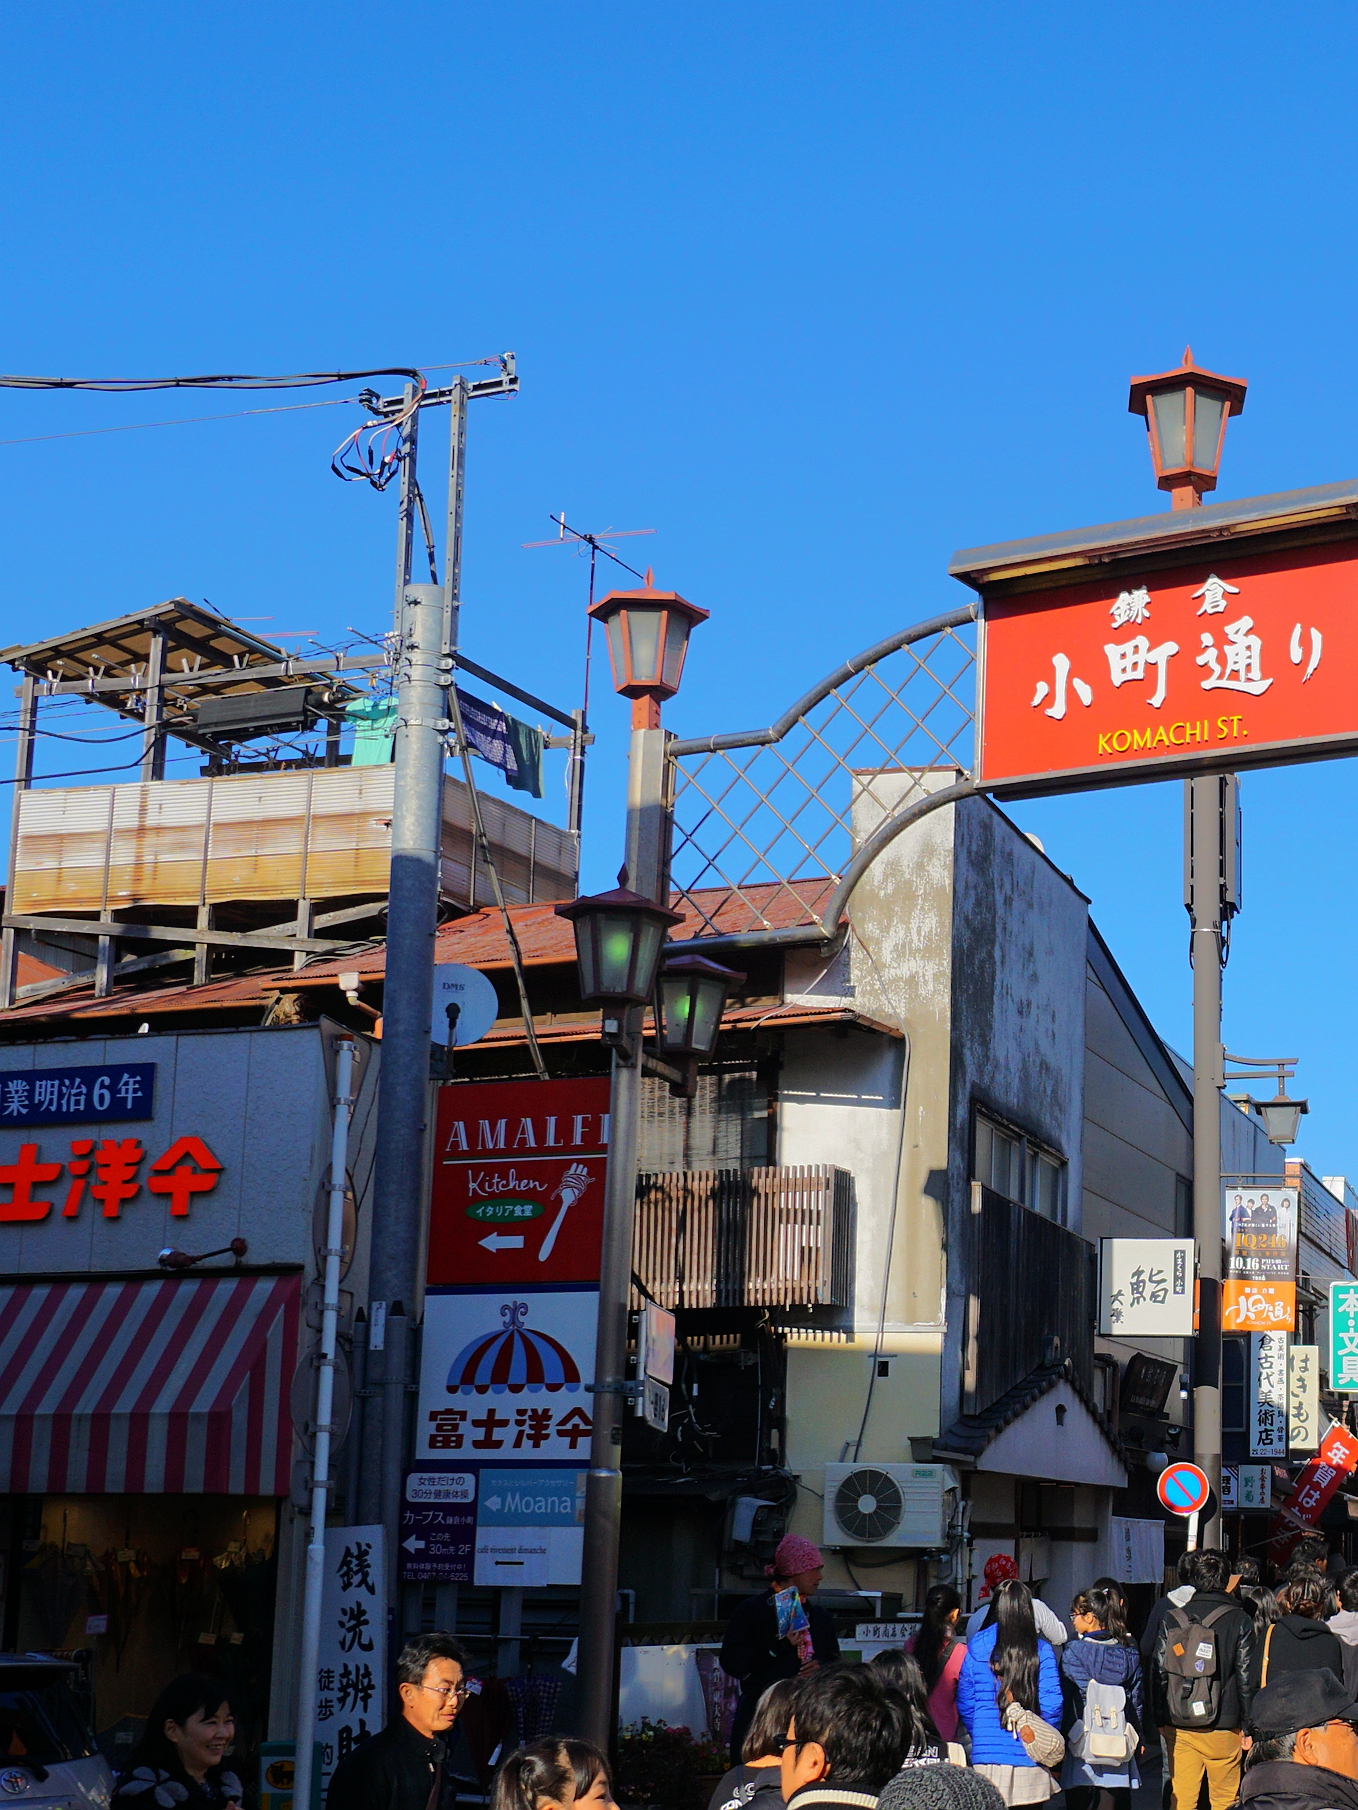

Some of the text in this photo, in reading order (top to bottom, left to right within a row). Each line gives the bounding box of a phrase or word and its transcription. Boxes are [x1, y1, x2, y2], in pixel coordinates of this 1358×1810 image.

[1109, 573, 1240, 629] 鎌倉
[1030, 616, 1323, 721] 小町通り
[1097, 715, 1250, 755] KOMACHI ST.
[0, 1072, 144, 1117] 業明治6年
[467, 1168, 549, 1197] Kitchen
[475, 1203, 534, 1217] イタリア食堂
[1229, 1257, 1260, 1271] 10.16
[1256, 1330, 1276, 1447] 倉古代美術店
[418, 1476, 465, 1486] 女性だけの
[504, 1491, 572, 1514] Moana
[402, 1510, 445, 1525] カーブス
[458, 1544, 472, 1555] 2F
[403, 1572, 416, 1581] TEL
